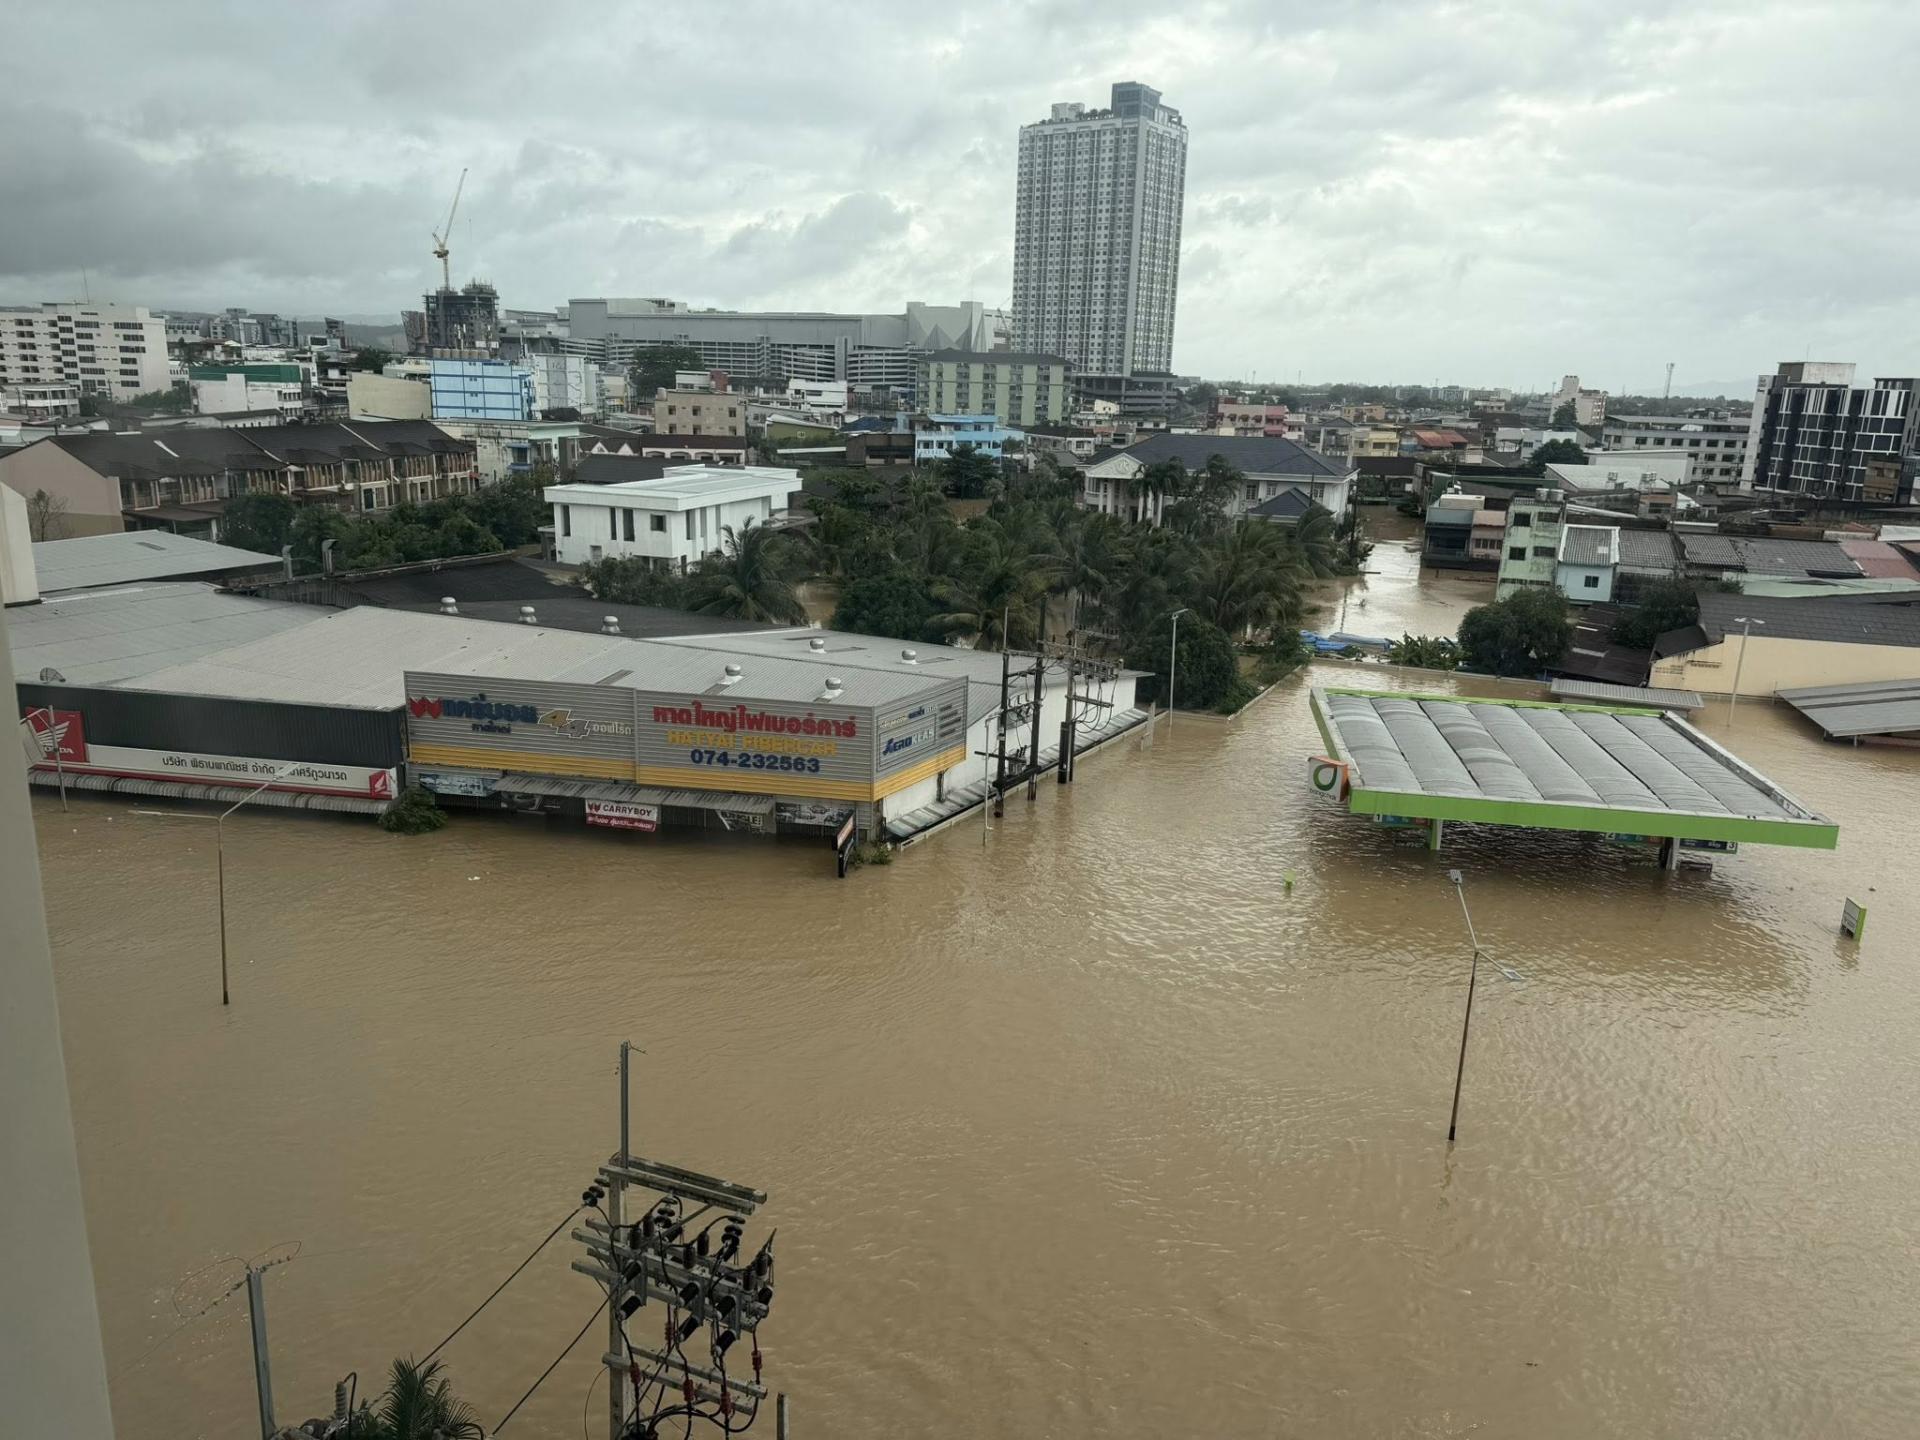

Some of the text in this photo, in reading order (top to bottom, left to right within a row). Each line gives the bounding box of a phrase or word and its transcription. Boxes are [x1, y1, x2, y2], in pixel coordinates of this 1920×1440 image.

[653, 699, 857, 738] หาดใหญ่ไฟเบอร์คาร์
[251, 762, 275, 775] จำกัด
[690, 748, 820, 773] 074-232563
[602, 804, 652, 817] CARRYBOY
